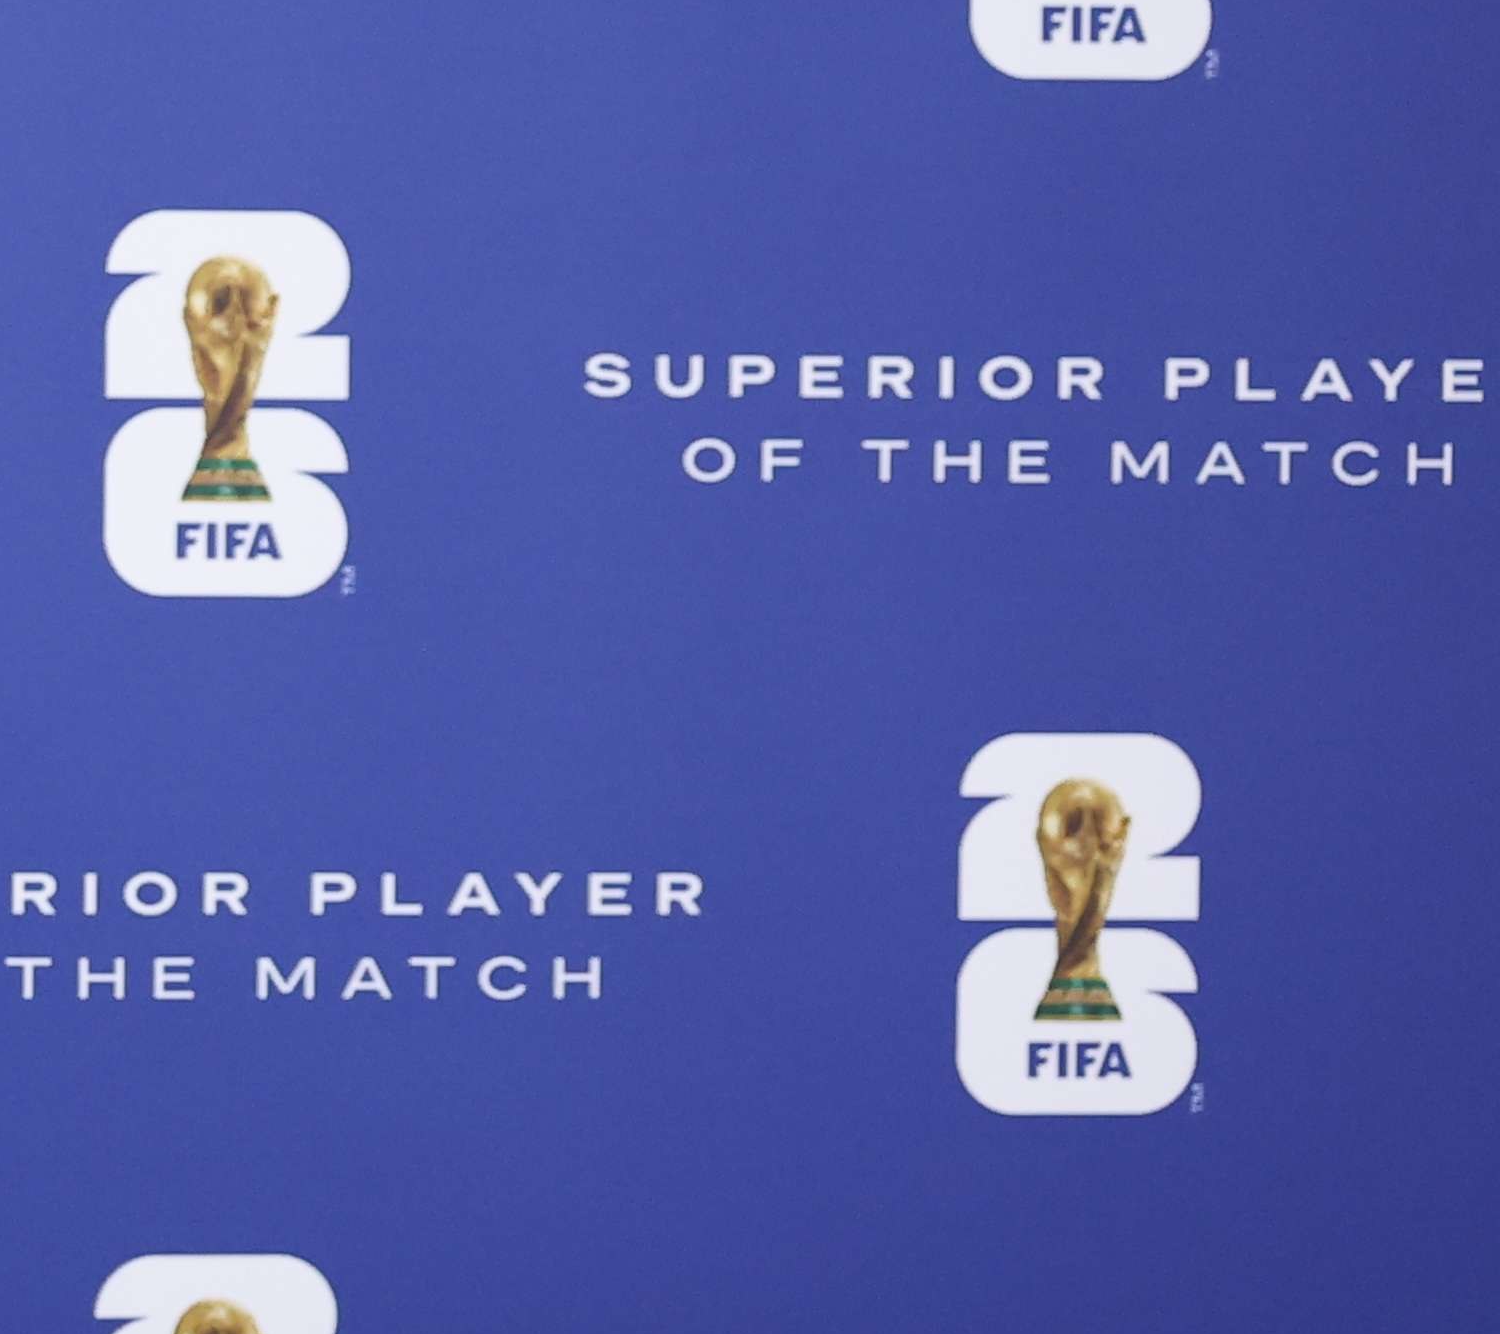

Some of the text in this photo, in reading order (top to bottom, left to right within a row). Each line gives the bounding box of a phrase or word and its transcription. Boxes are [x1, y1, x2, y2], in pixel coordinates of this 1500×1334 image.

[1041, 5, 1146, 44] FIFA
[583, 352, 1485, 404] SUPERIOR PLAYE
[681, 437, 1454, 487] OF THE MATCH
[175, 521, 282, 561] FIFA
[309, 871, 704, 917] PLAYER
[3, 955, 196, 1001] THE
[255, 954, 602, 1001] MATCH
[1026, 1041, 1132, 1079] FIFA
